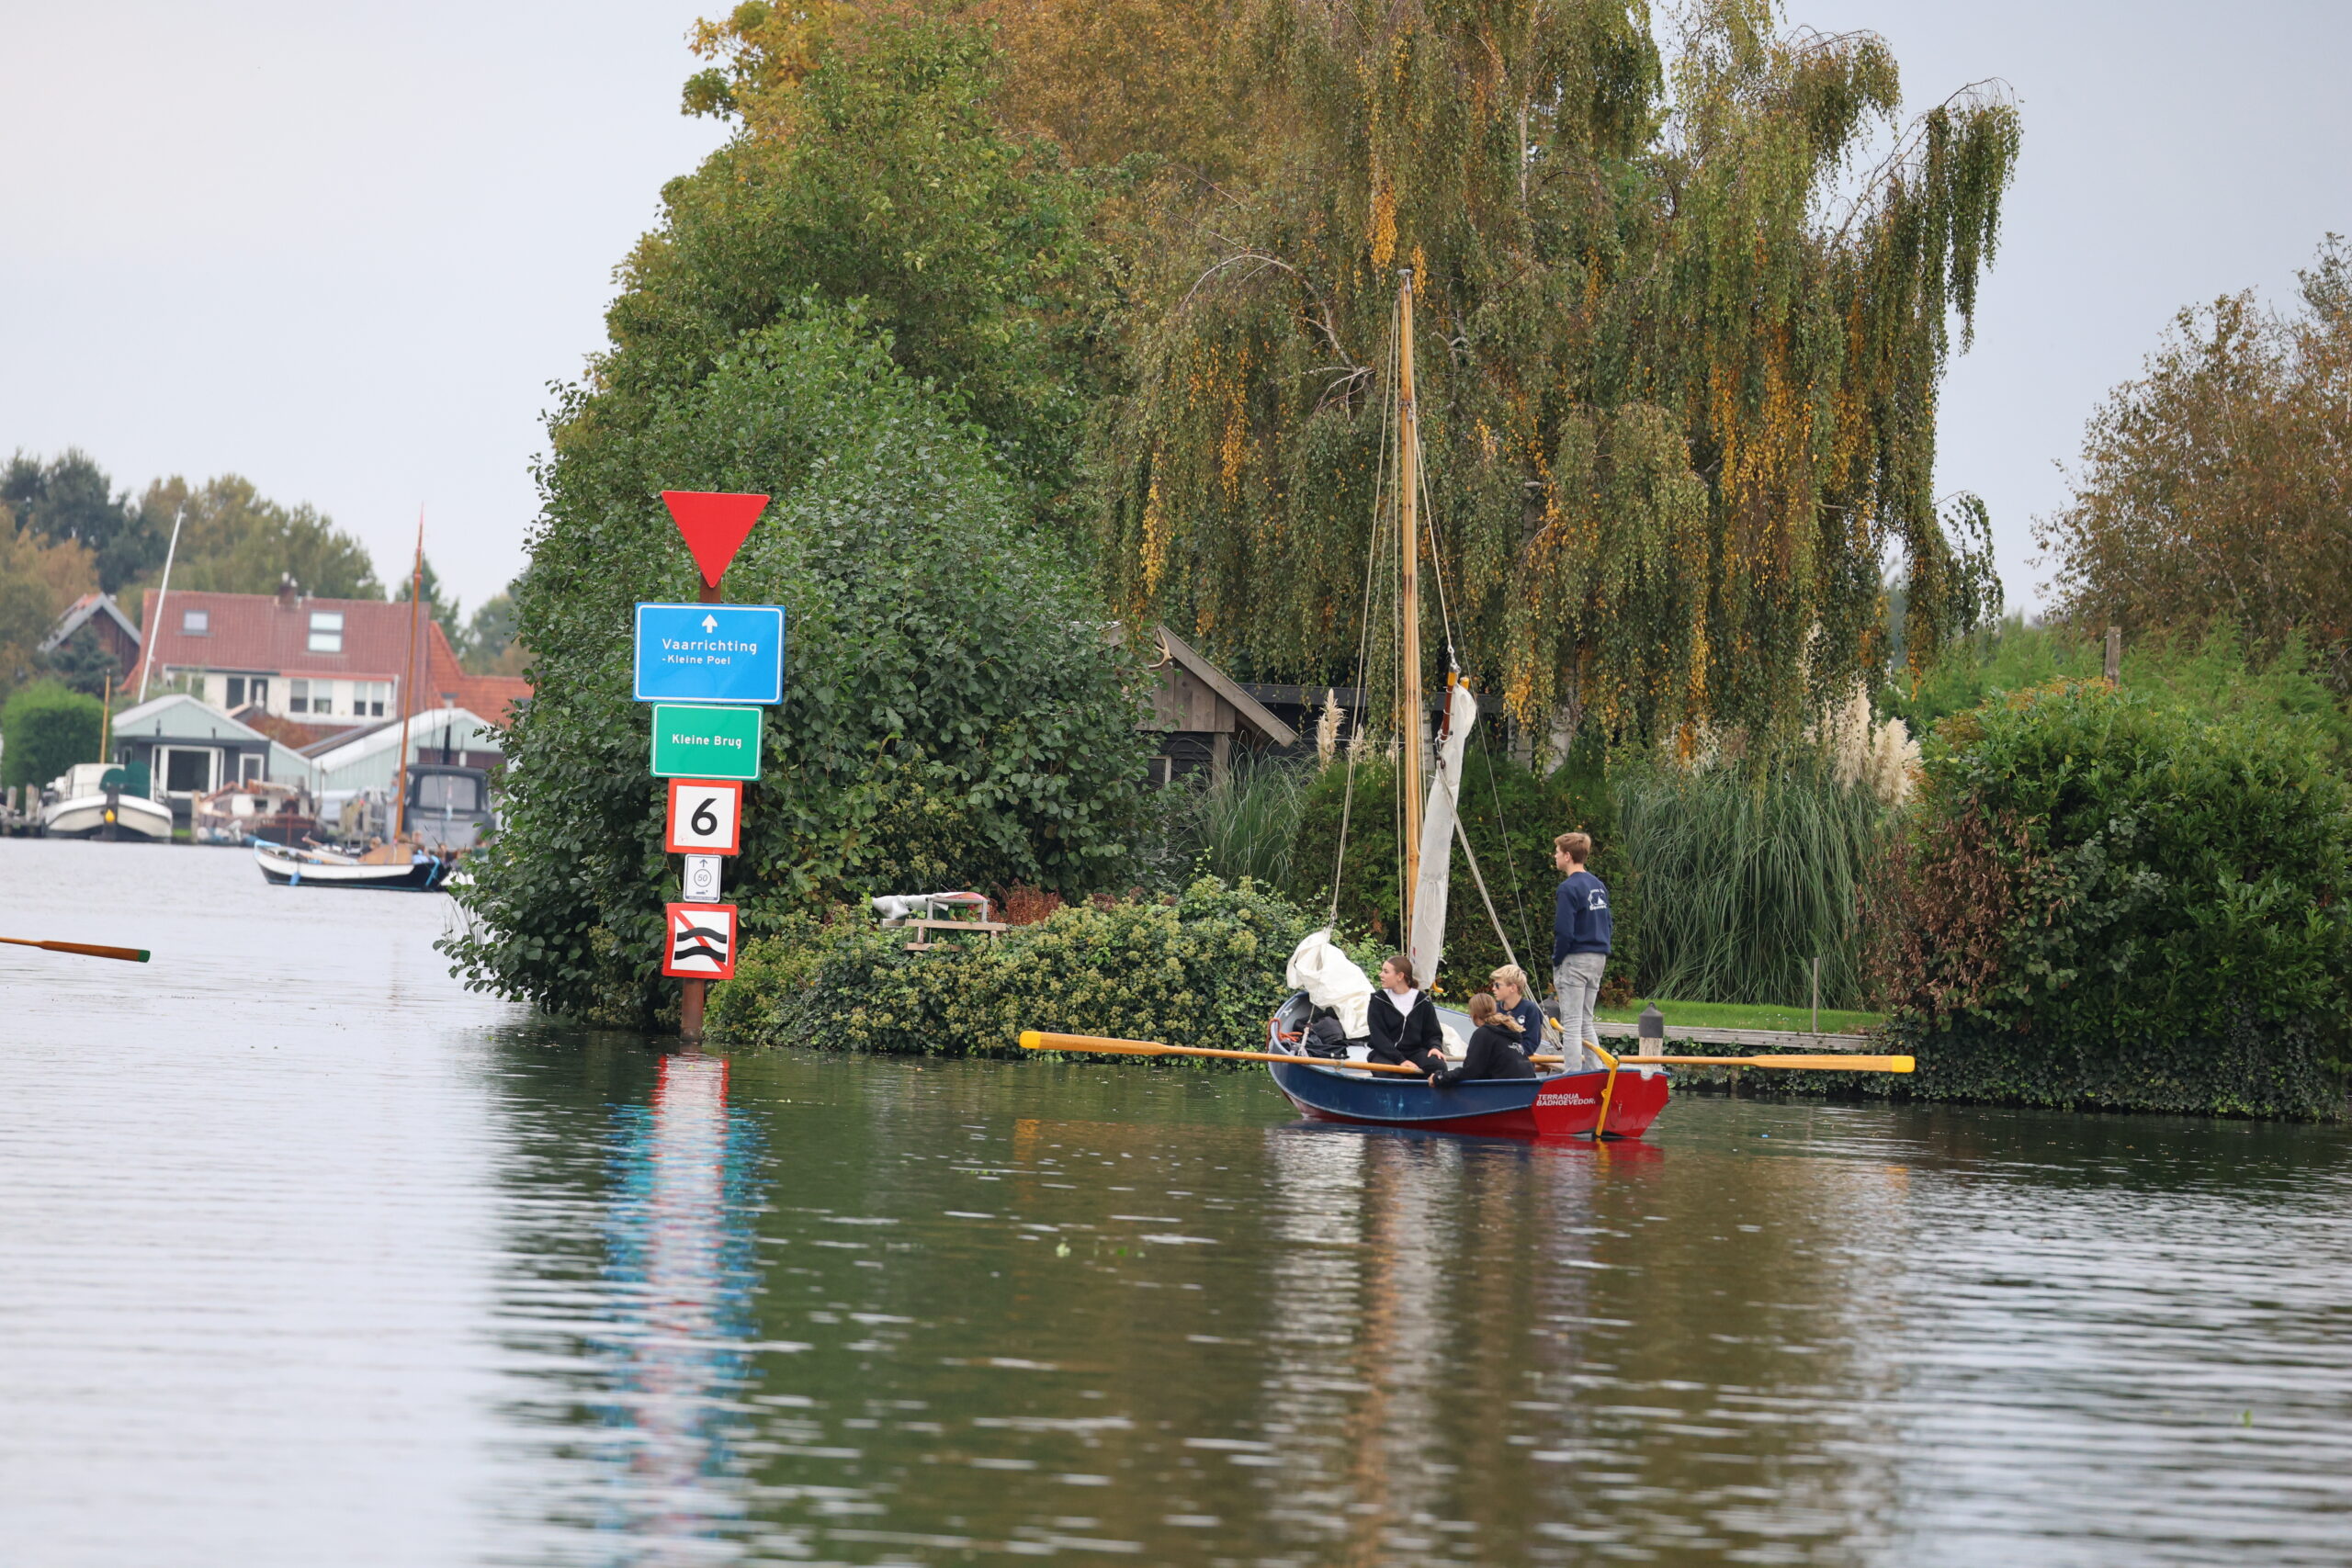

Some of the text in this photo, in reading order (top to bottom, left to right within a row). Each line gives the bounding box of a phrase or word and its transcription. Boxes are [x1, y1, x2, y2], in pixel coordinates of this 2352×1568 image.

[662, 638, 757, 655] Vaarrichting
[707, 655, 730, 665] Poel
[672, 734, 742, 750] Kleine Brug
[691, 798, 718, 836] 6
[697, 874, 708, 882] 50
